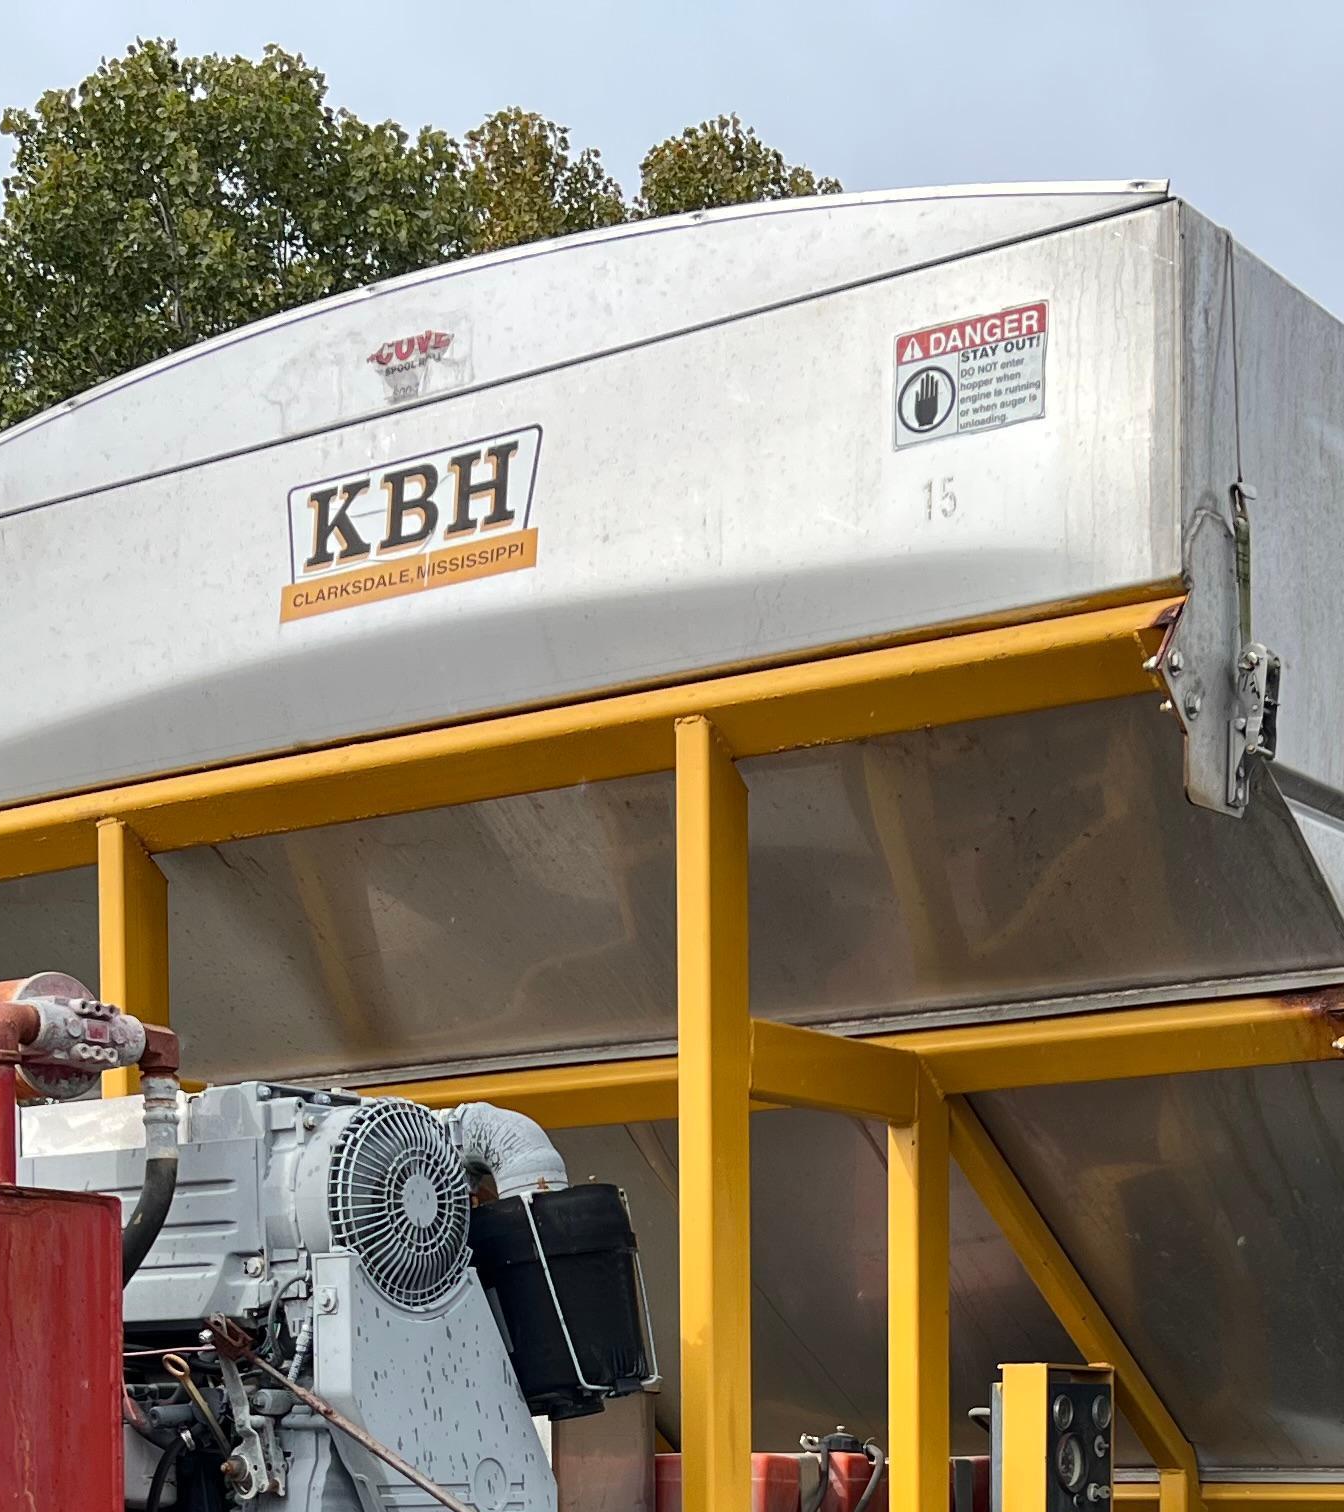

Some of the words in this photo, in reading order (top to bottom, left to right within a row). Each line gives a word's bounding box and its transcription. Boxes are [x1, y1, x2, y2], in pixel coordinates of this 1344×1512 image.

[929, 308, 1039, 355] DANGER
[961, 345, 1000, 364] STAY
[1003, 334, 1041, 354] OUT!
[960, 368, 976, 379] DO
[977, 363, 999, 375] NOT
[1000, 357, 1025, 370] enter
[960, 376, 993, 392] hopper
[995, 371, 1022, 384] when
[959, 408, 970, 418] or
[972, 402, 998, 414] when
[999, 395, 1027, 409] auger
[1028, 392, 1038, 402] is
[960, 392, 992, 406] engine
[994, 387, 1003, 397] is
[1004, 379, 1041, 395] running
[959, 413, 1008, 430] unloading.
[303, 440, 519, 573] KBH
[292, 567, 415, 609] CLARKSDALE,
[416, 541, 525, 581] MISSISSIPPI
